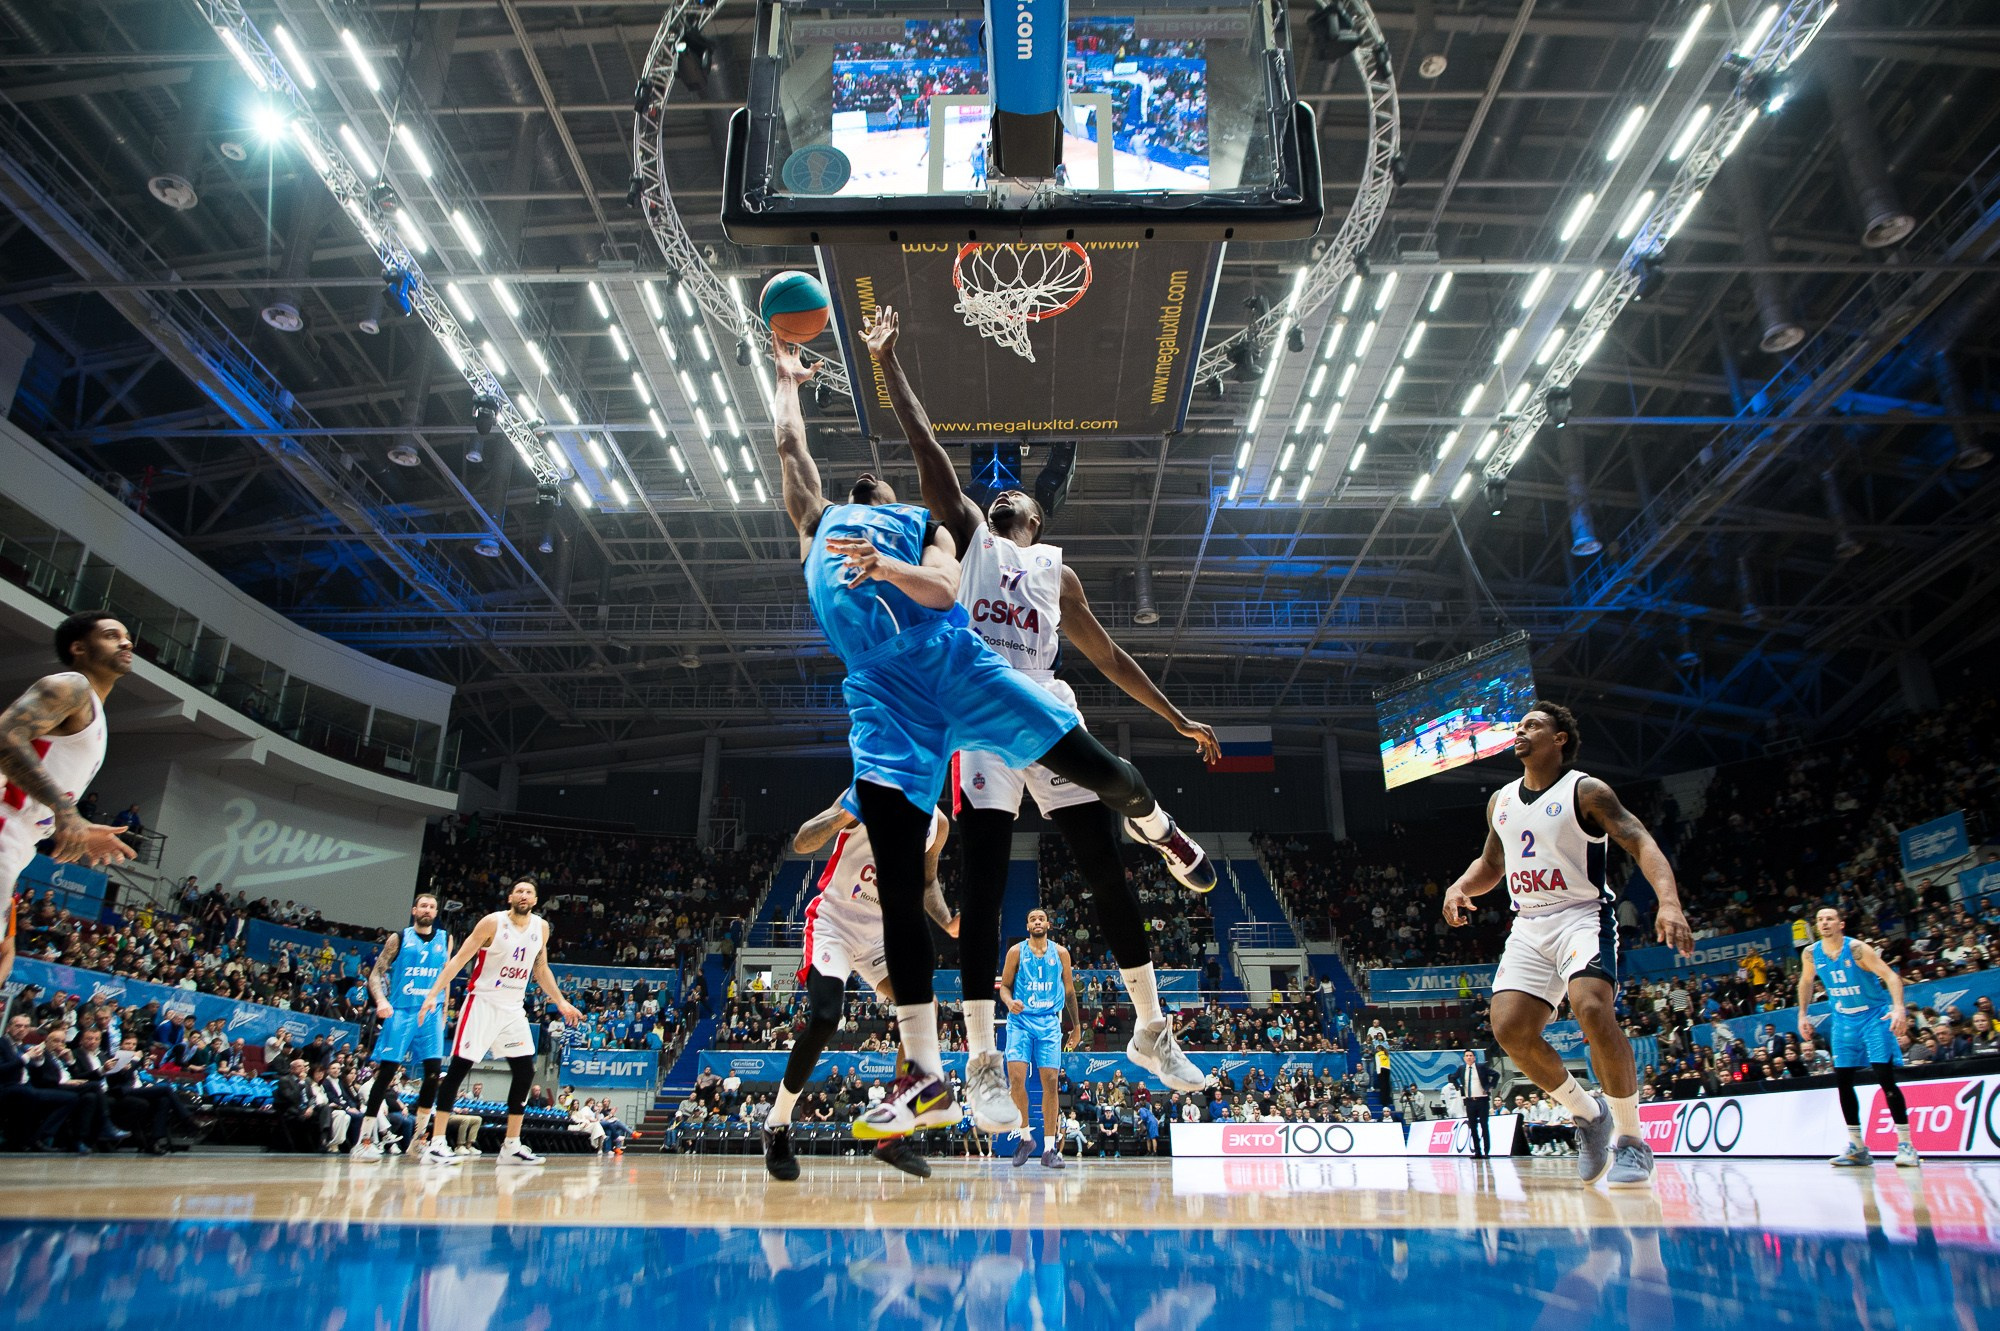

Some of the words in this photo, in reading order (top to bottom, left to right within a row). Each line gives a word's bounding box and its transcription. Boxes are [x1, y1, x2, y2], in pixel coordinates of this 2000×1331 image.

[1150, 270, 1189, 405] www.megaluxltd.com
[931, 418, 1118, 433] www.megaluxltd.com
[972, 599, 1039, 634] CSKA
[186, 798, 409, 893] Зенит
[1521, 830, 1536, 858] 2
[1510, 869, 1568, 894] CSKA
[420, 951, 429, 963] 7
[513, 947, 526, 961] 41
[1674, 938, 1771, 968] ПОБЕДЫ
[405, 967, 438, 978] ZENIT
[500, 966, 528, 979] CSKA
[1038, 966, 1043, 978] 1
[1830, 970, 1847, 983] 13
[1027, 982, 1053, 991] ZENIT
[570, 1060, 648, 1076] ЗЕНИТ
[1675, 1099, 1743, 1152] 100
[1229, 1133, 1275, 1146] ЭКТО
[1278, 1125, 1354, 1154] 100
